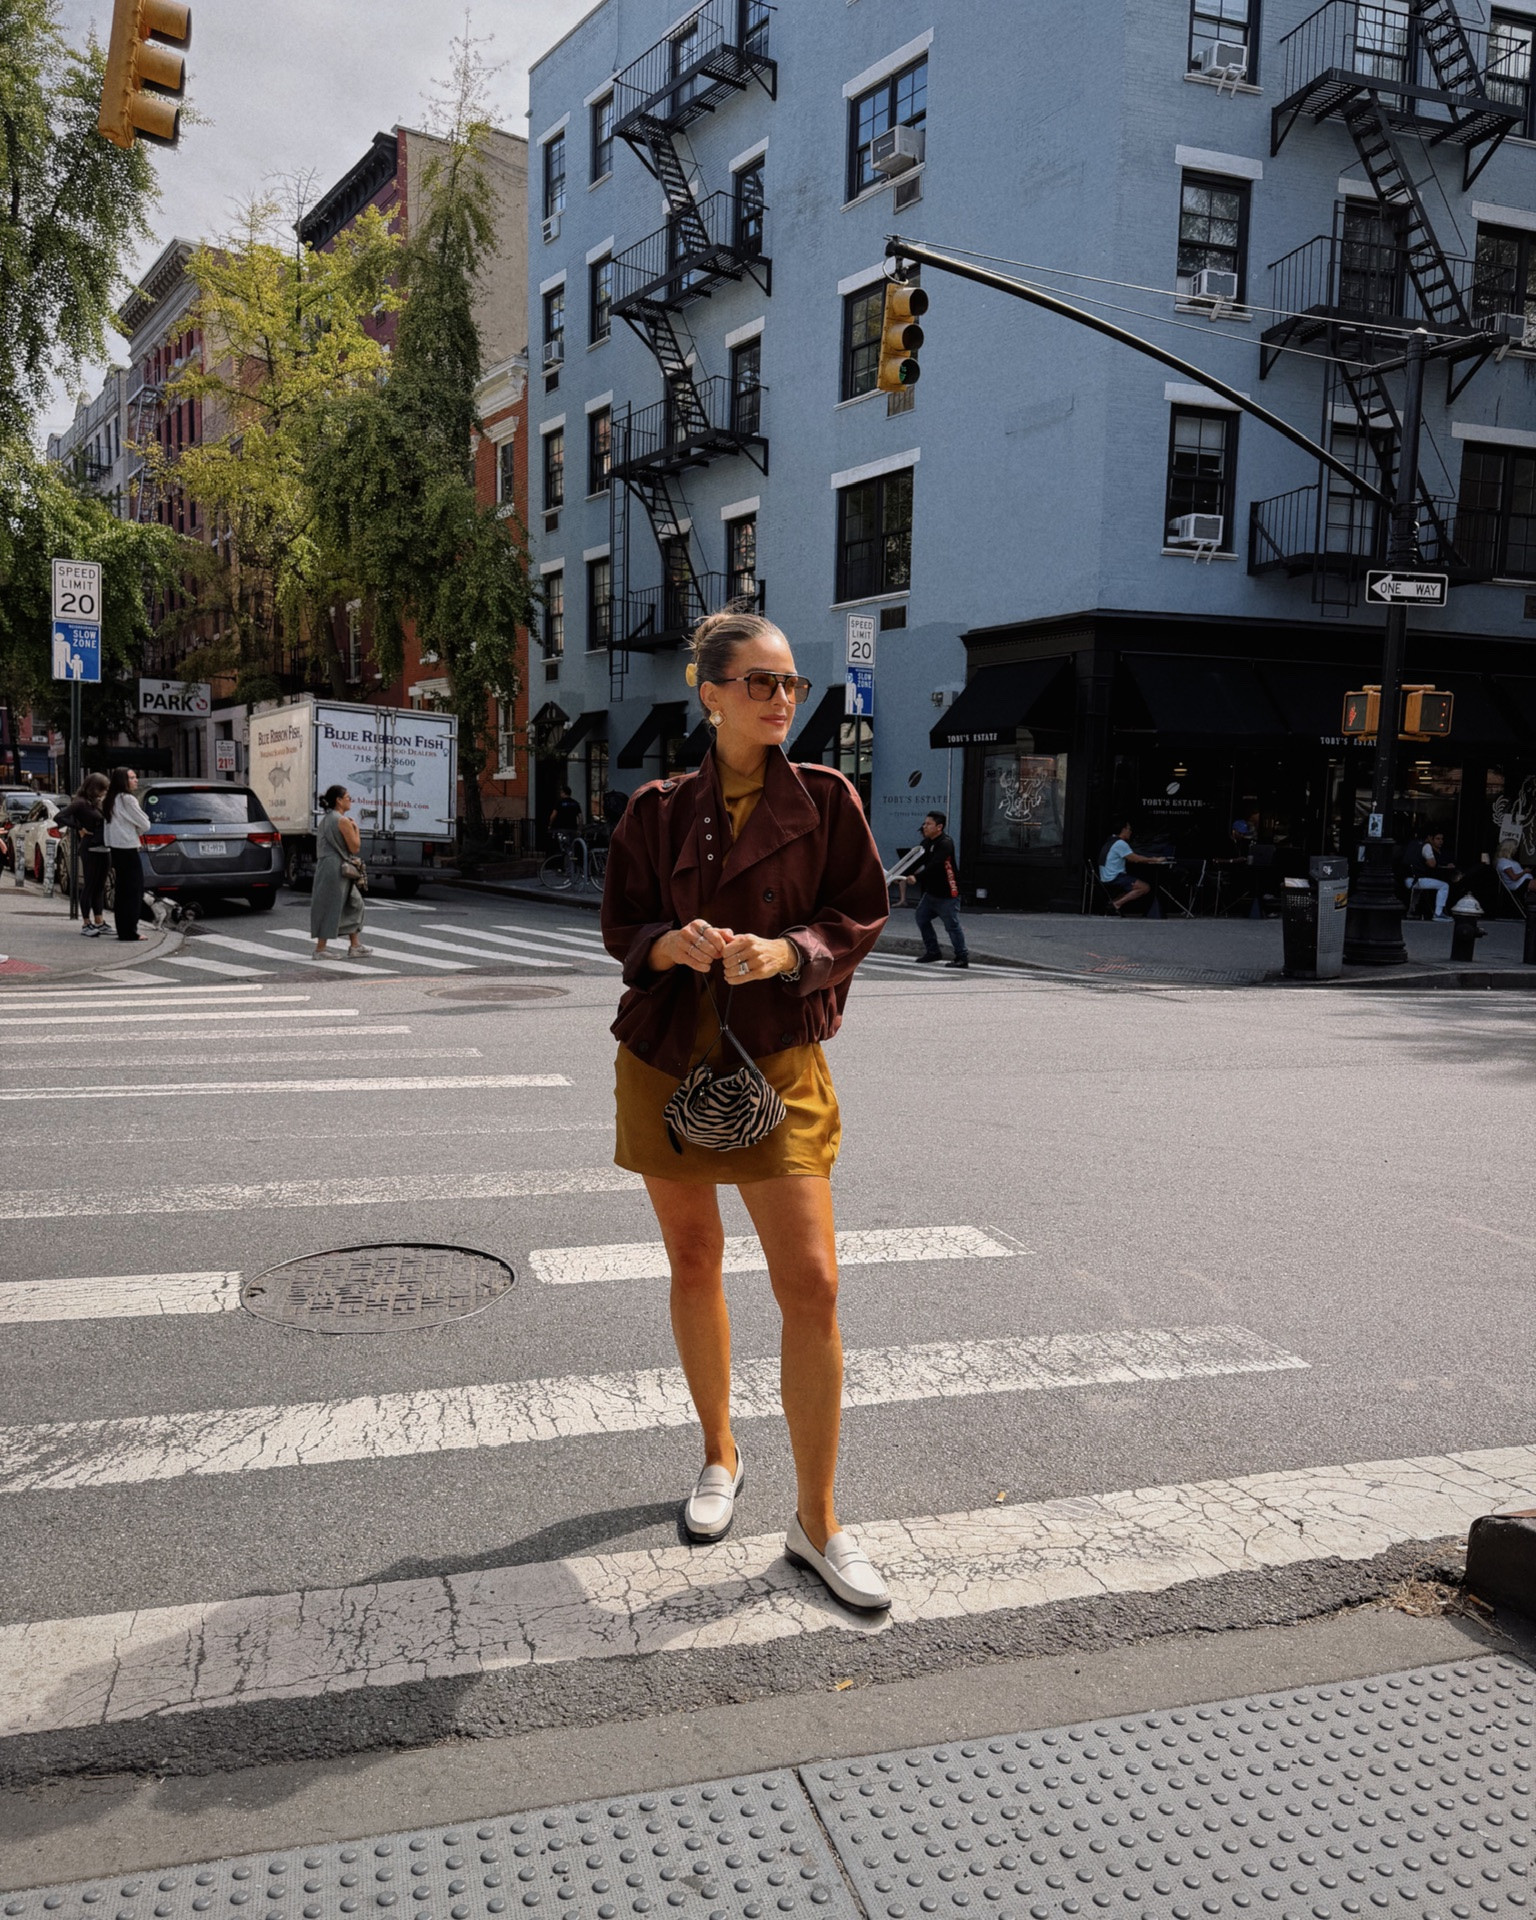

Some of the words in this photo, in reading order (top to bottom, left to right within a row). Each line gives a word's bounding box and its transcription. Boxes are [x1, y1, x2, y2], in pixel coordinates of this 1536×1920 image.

[58, 566, 96, 580] SPEED
[61, 579, 94, 591] LIMIT
[1380, 582, 1402, 594] ONE
[1416, 583, 1439, 596] WAY
[60, 592, 95, 615] 20
[851, 619, 873, 630] SPEED
[73, 629, 97, 640] SLOW
[852, 630, 872, 640] LIMIT
[72, 638, 97, 649] ZONE
[851, 641, 872, 660] 20
[143, 692, 194, 712] PARK
[324, 726, 359, 742] BLUE
[362, 730, 412, 747] RIBBON
[415, 735, 444, 750] FISH
[947, 734, 970, 743] TOBY'S
[973, 732, 998, 742] ESTATE
[1320, 736, 1348, 745] TOBY'S
[883, 795, 912, 804] TOBY'S
[915, 795, 948, 804] ESTATE
[1141, 798, 1170, 807] TOBY'S
[1172, 799, 1203, 807] ESTATE
